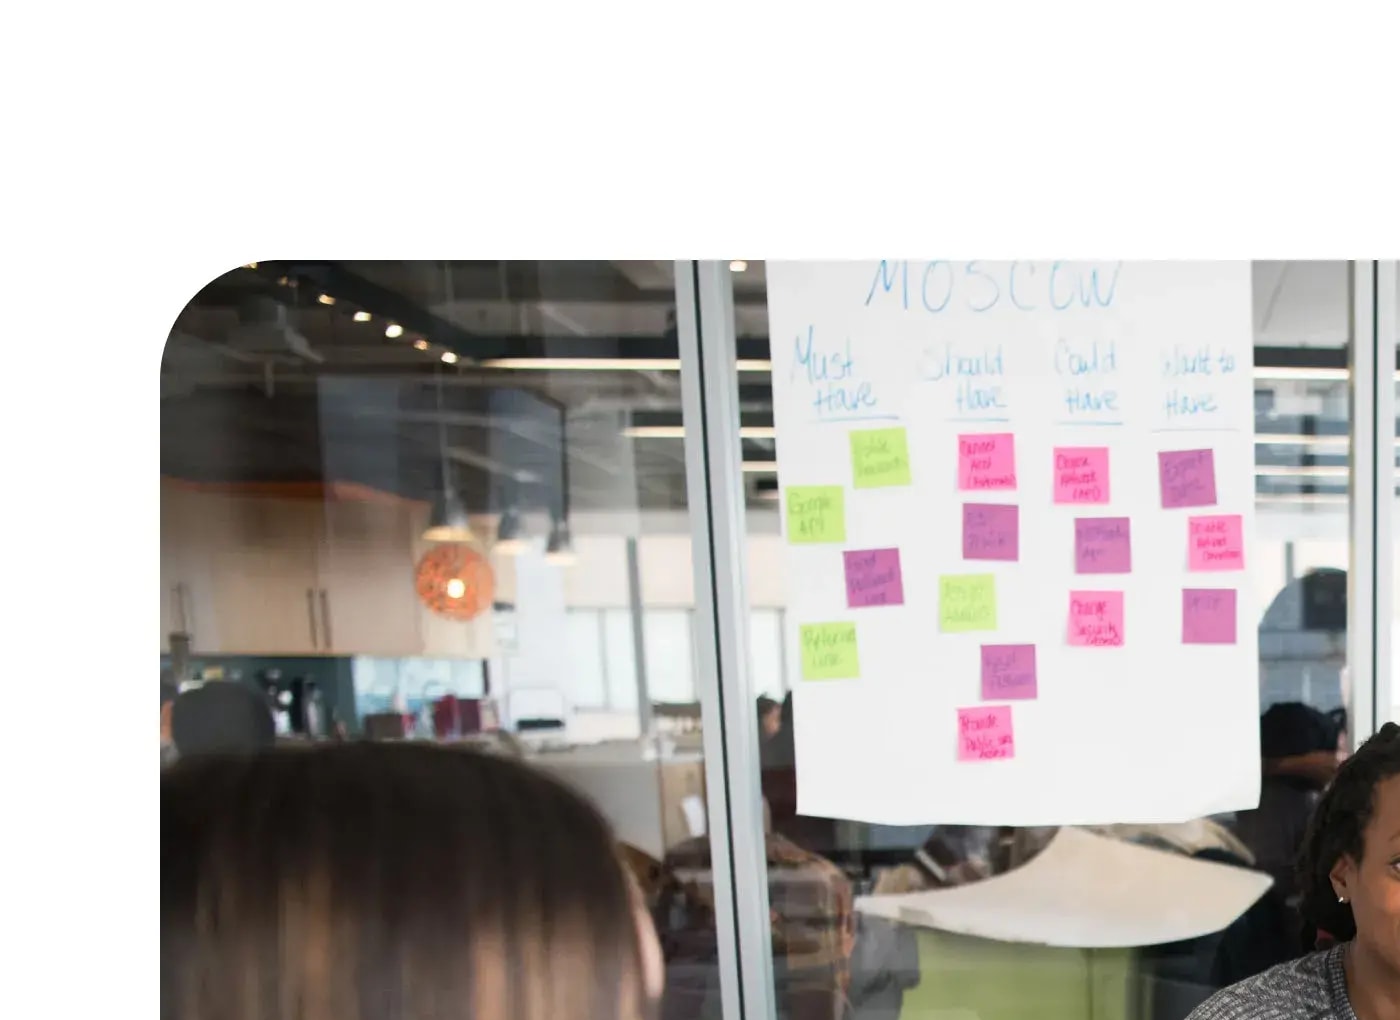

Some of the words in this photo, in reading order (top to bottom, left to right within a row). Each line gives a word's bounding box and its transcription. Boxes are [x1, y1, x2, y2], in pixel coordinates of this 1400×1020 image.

[791, 325, 854, 384] Must
[916, 342, 1004, 381] Should
[1054, 338, 1116, 375] Could
[813, 382, 877, 416] Have
[956, 378, 1008, 414] Have
[1064, 385, 1120, 415] Have
[1165, 388, 1218, 419] Have
